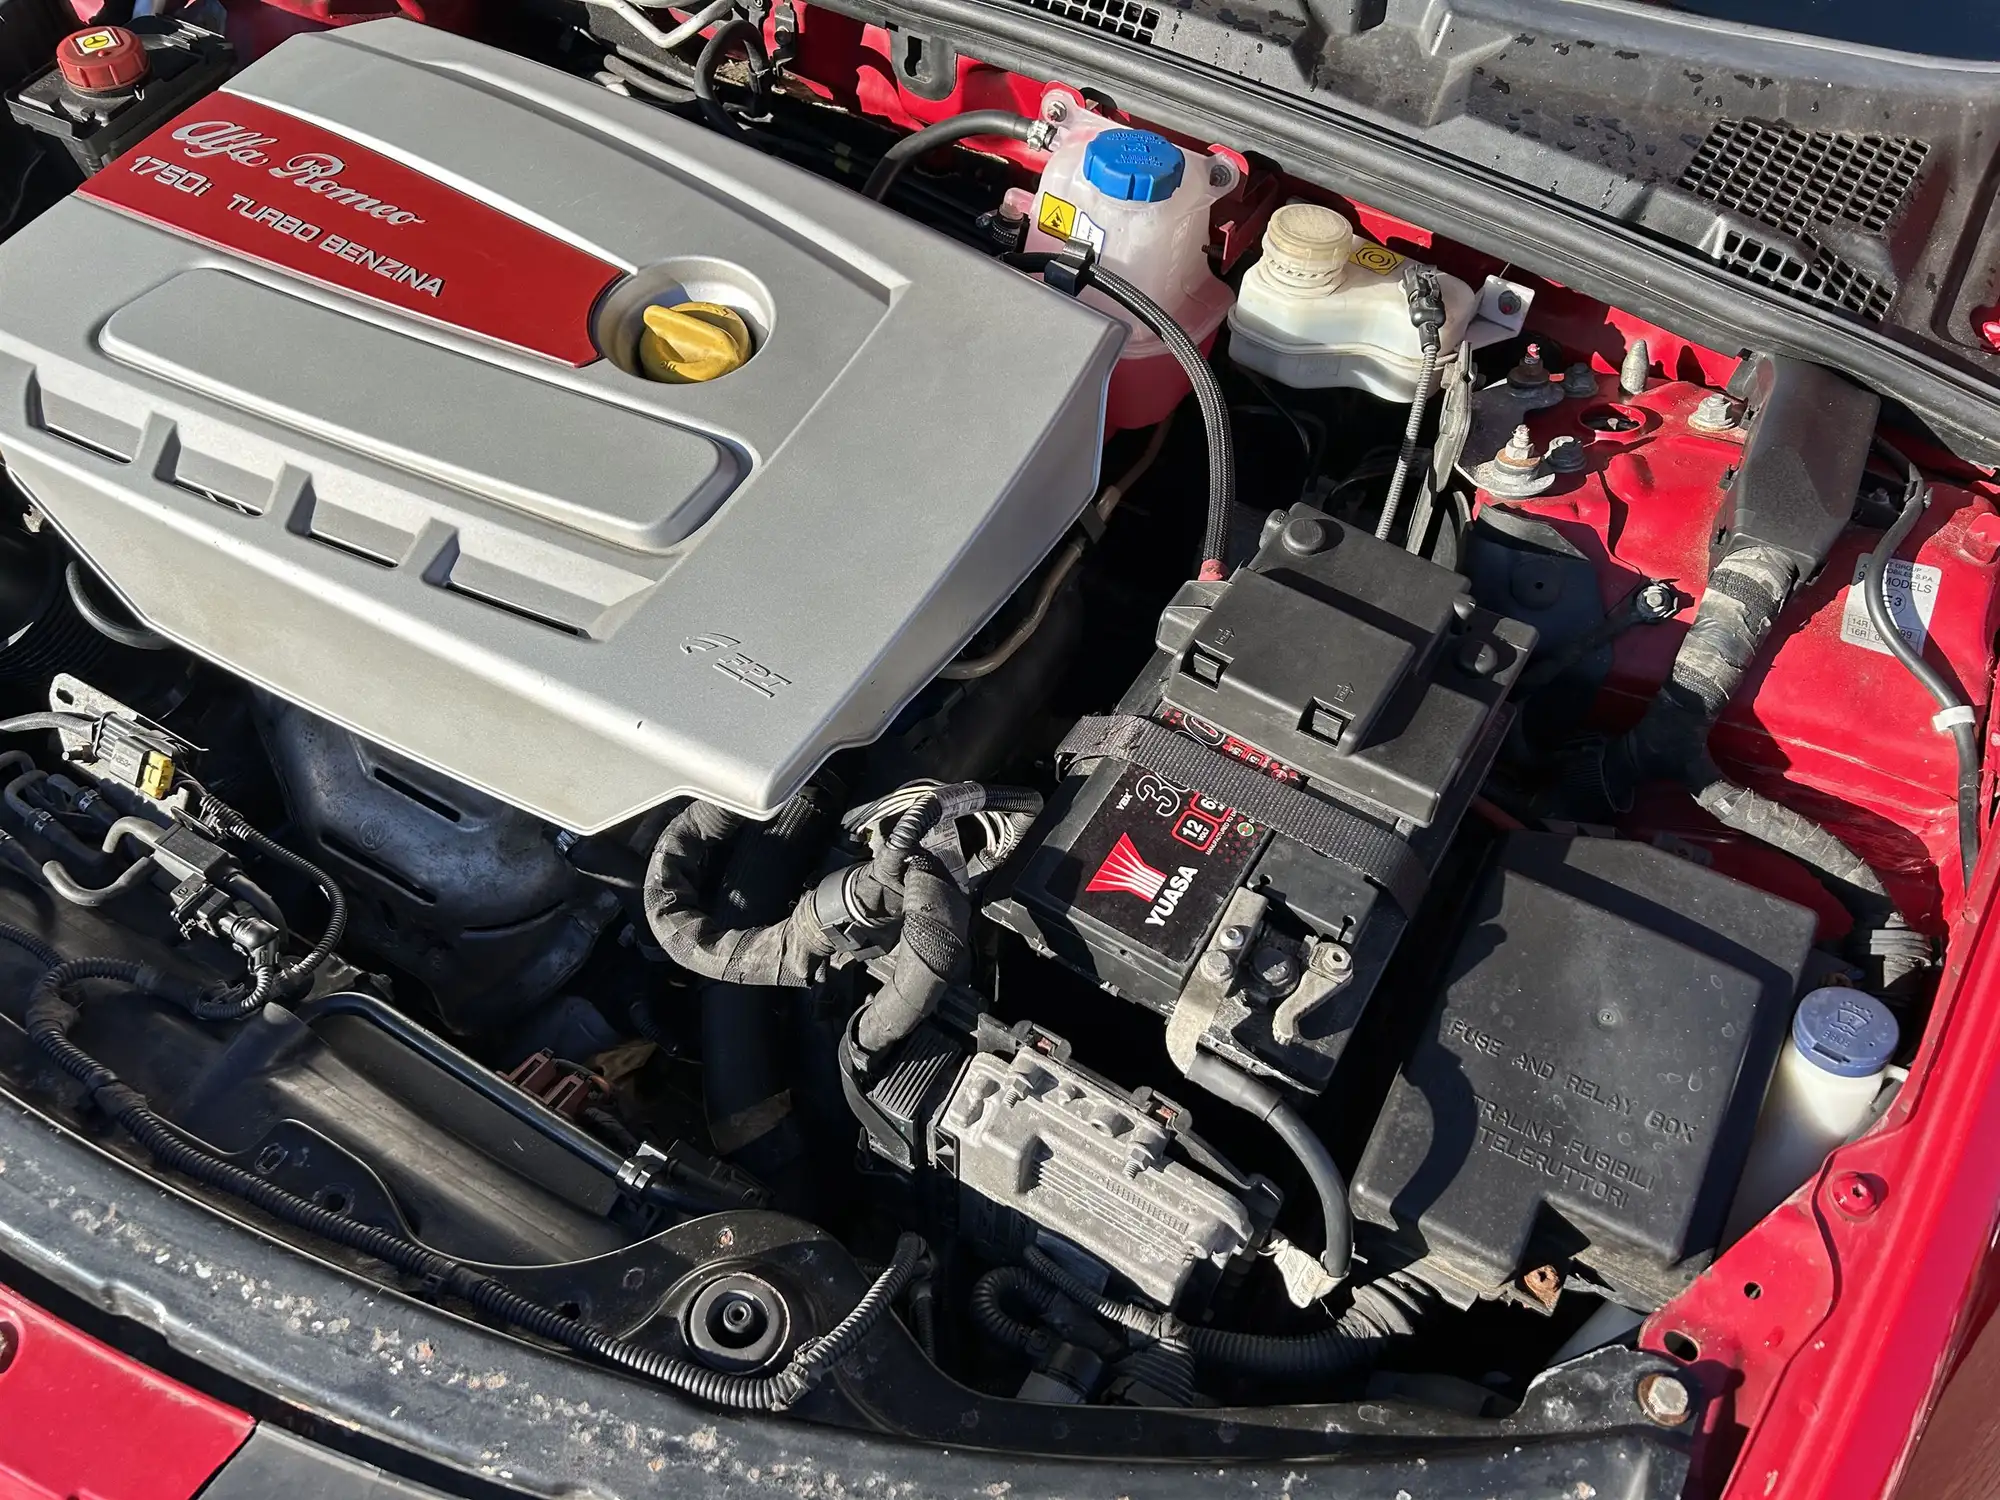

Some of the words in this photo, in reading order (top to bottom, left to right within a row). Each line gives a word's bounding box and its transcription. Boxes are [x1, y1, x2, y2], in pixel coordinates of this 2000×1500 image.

[171, 120, 278, 167] Alfa
[268, 152, 427, 226] Romeo
[128, 155, 215, 197] 1750i
[227, 193, 323, 243] TURBO
[318, 233, 445, 298] BENZINA
[1884, 578, 1933, 594] MODELS
[1182, 819, 1204, 838] 12
[1197, 827, 1210, 841] VOLT
[1145, 865, 1199, 927] YUASA
[1450, 1019, 1505, 1057] FUSE
[1511, 1052, 1556, 1080] AND
[1564, 1073, 1638, 1116] RELAY
[1646, 1110, 1698, 1143] BOX
[1478, 1125, 1630, 1209] TELERUTTORI
[1565, 1139, 1656, 1192] FUSIBILI
